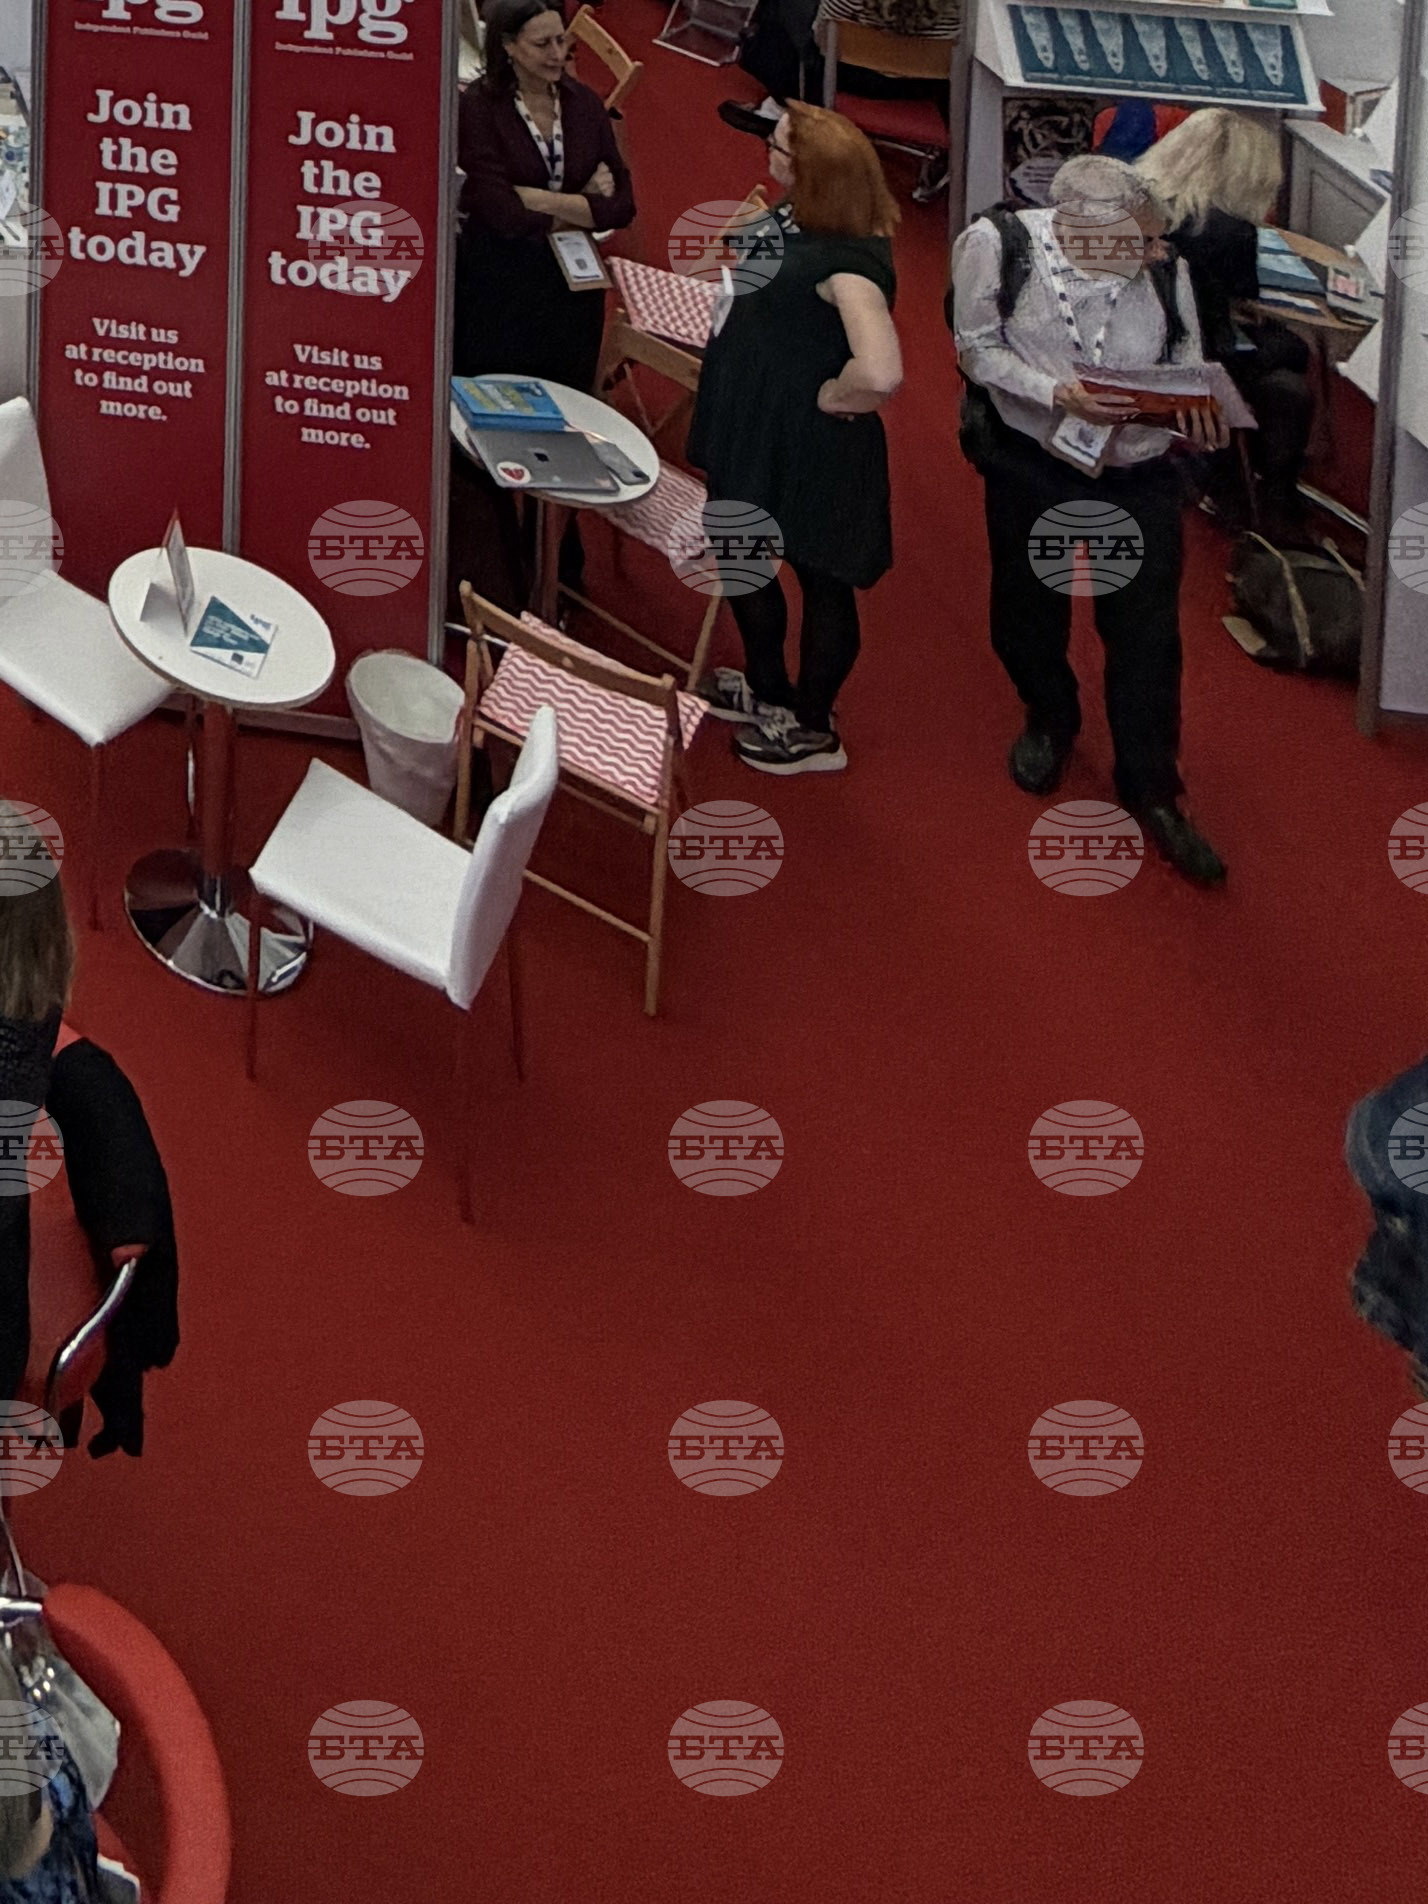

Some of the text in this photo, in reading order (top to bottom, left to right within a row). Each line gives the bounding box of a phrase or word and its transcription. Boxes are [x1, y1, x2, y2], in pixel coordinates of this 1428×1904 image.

[87, 89, 192, 132] Join
[99, 136, 177, 176] the
[95, 181, 181, 223] IPG
[68, 225, 206, 278] today
[92, 317, 178, 345] Visit us
[65, 342, 205, 373] at reception
[74, 368, 192, 399] to find out
[99, 398, 168, 422] more.
